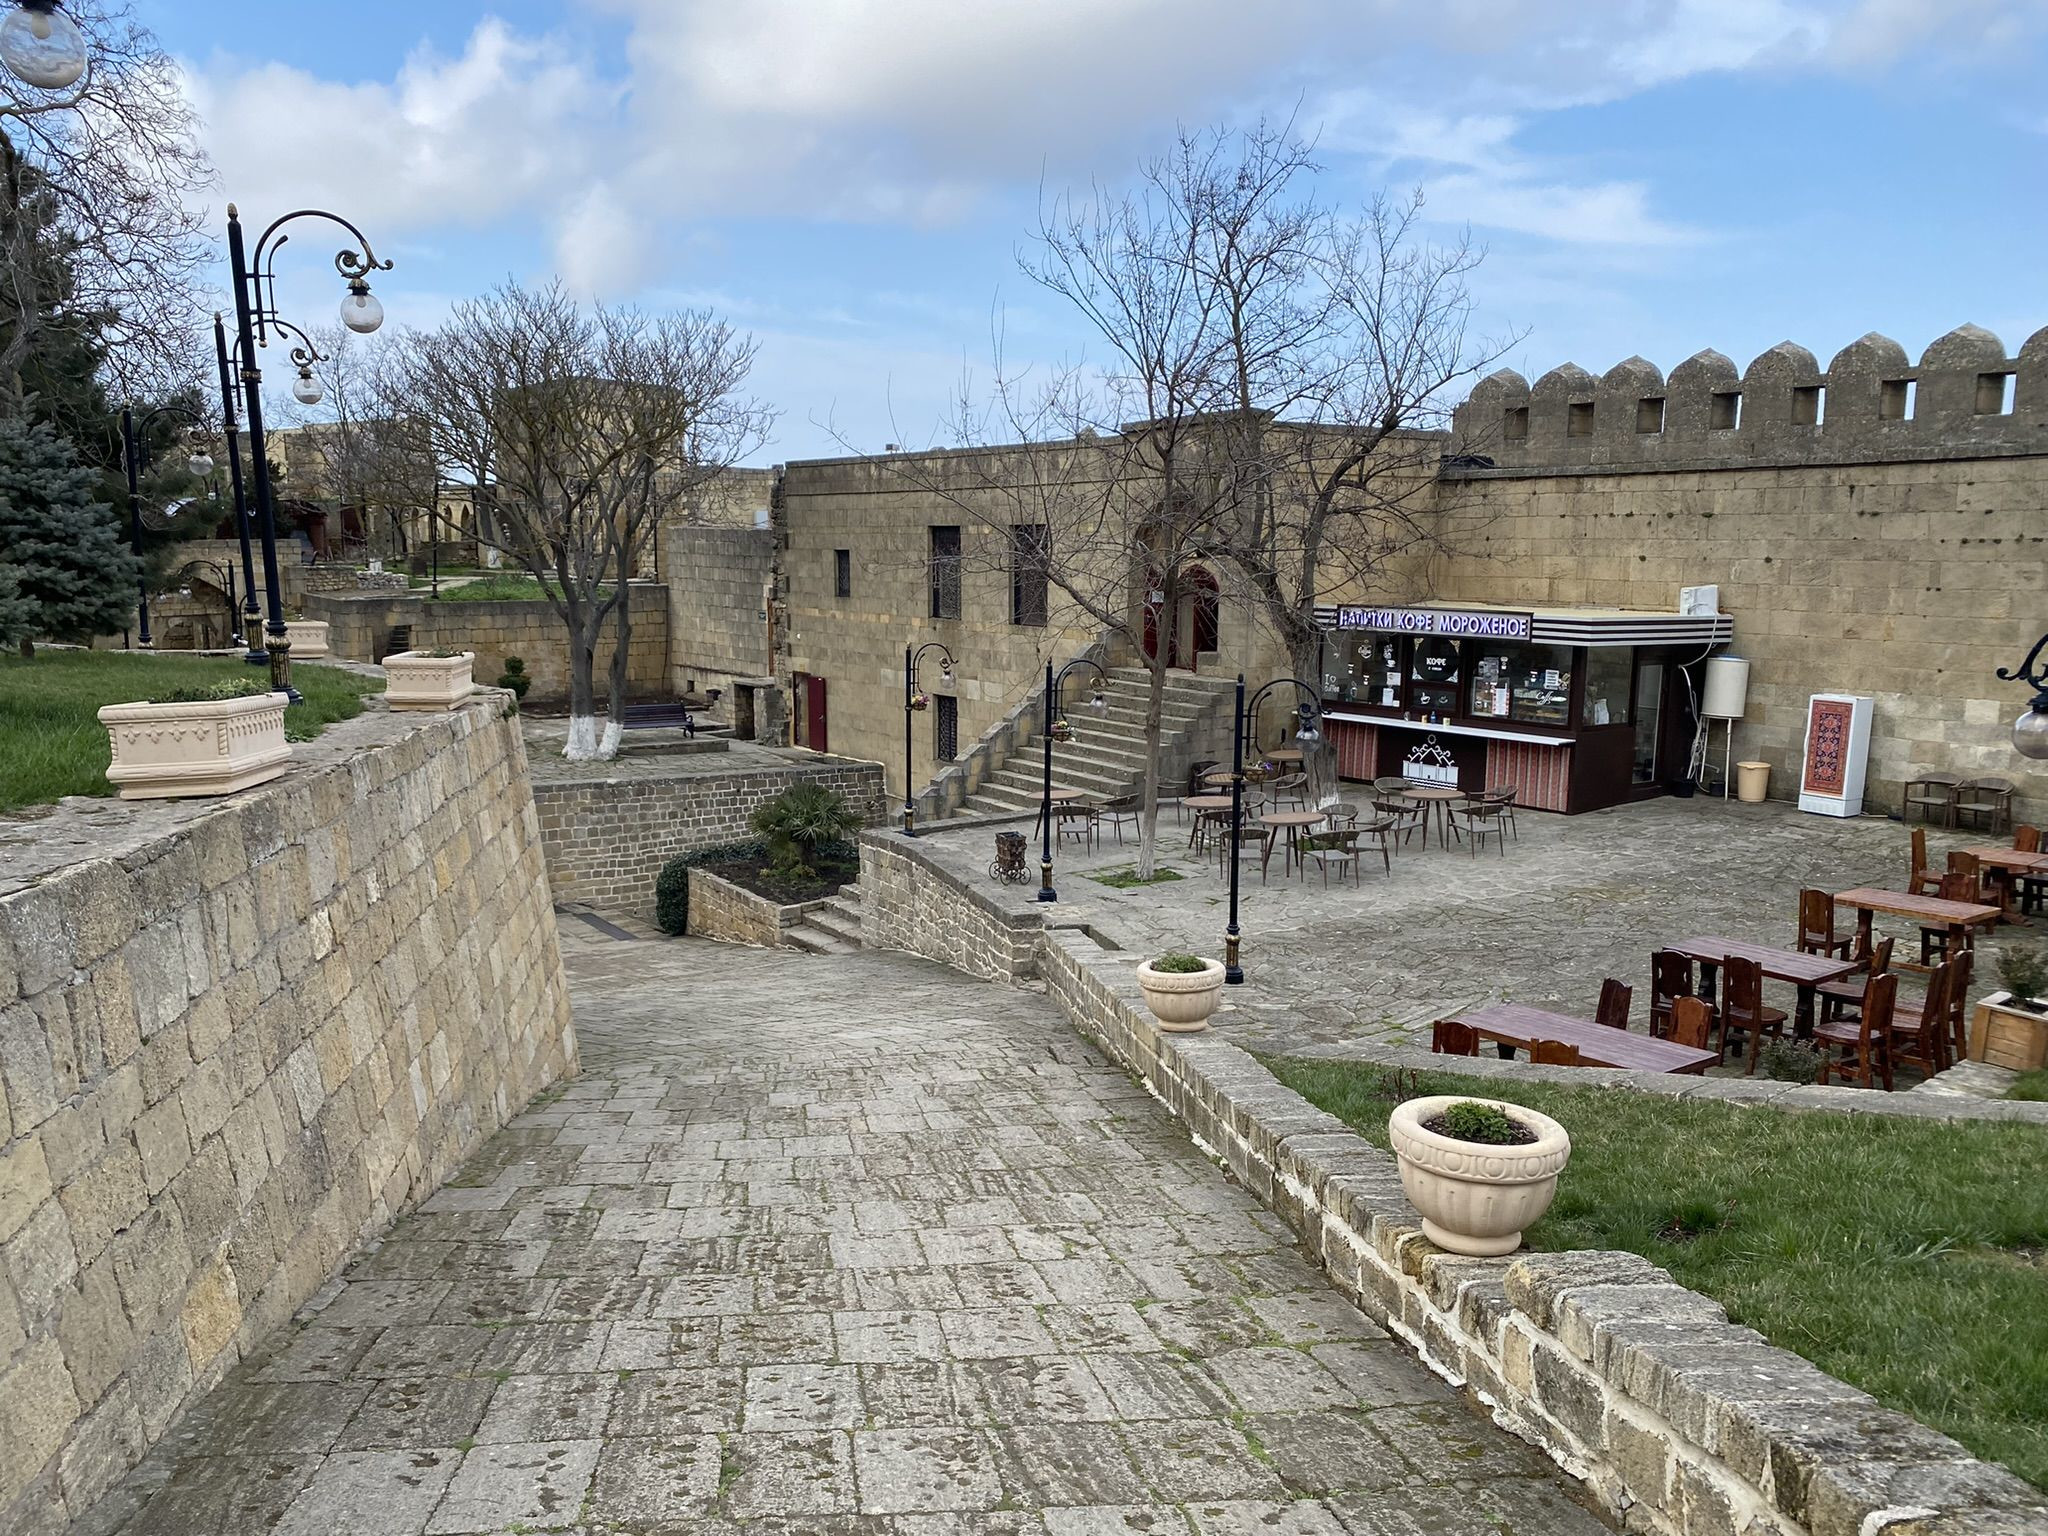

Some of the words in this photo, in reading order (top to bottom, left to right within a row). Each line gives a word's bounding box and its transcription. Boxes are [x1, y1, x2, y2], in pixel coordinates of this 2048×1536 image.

[1339, 609, 1393, 628] НАПИТКИ
[1398, 612, 1433, 631] КОФЕ
[1438, 614, 1528, 636] МОРОЖЕНОЕ
[1426, 657, 1447, 666] КОФЕ
